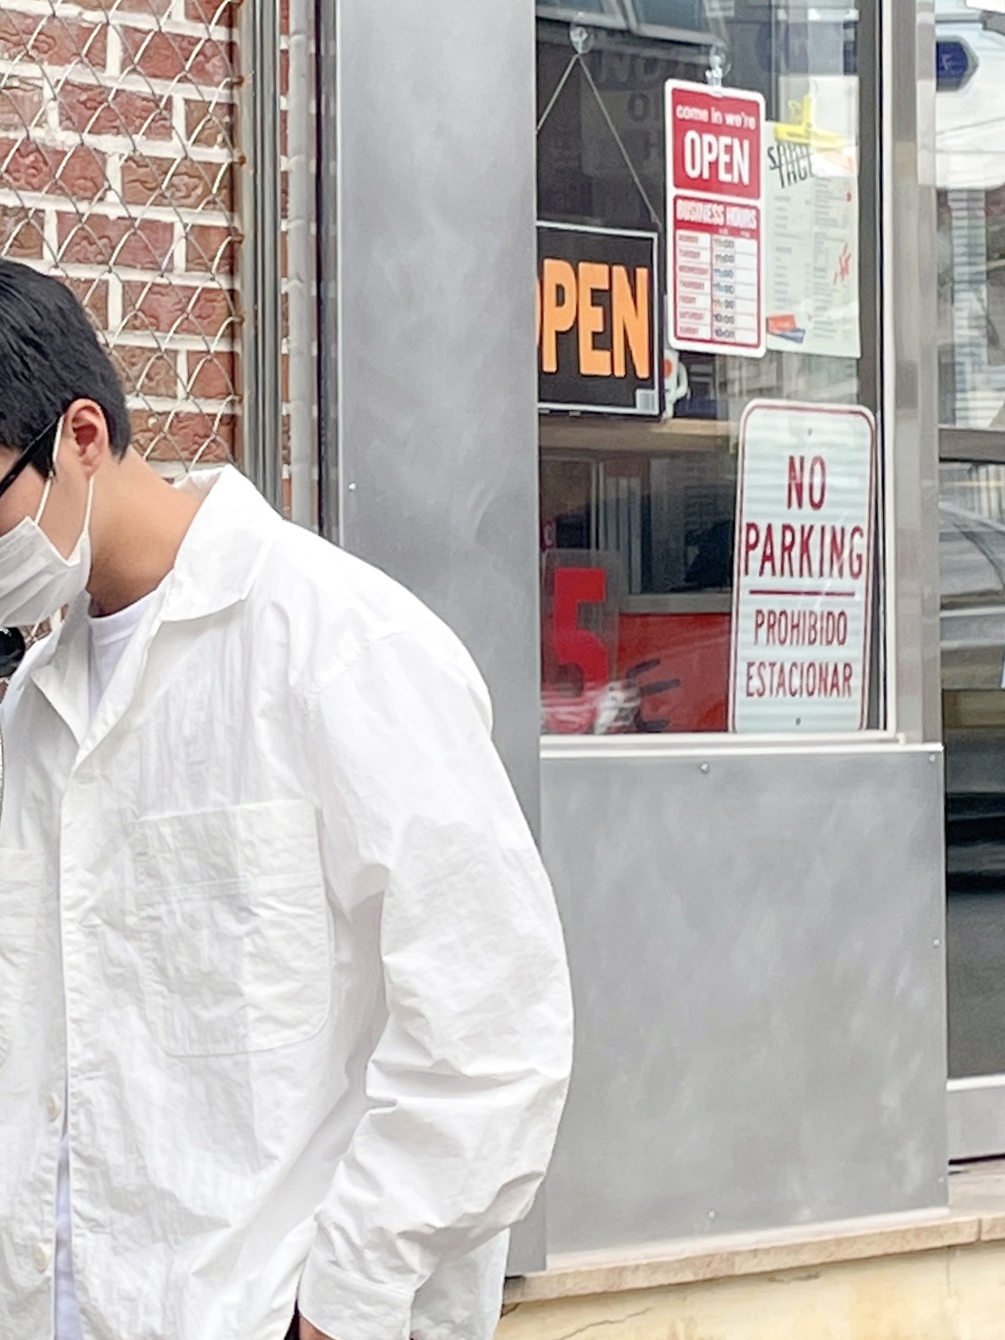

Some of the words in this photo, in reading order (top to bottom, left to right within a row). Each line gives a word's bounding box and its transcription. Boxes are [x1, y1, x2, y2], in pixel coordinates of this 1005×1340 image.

[711, 106, 722, 124] in
[684, 129, 750, 185] OPEN
[536, 257, 650, 379] PEN
[787, 455, 826, 510] NO
[744, 522, 864, 580] PARKING
[753, 609, 847, 646] PROHIBIDO
[746, 661, 853, 698] ESTACIONAR
